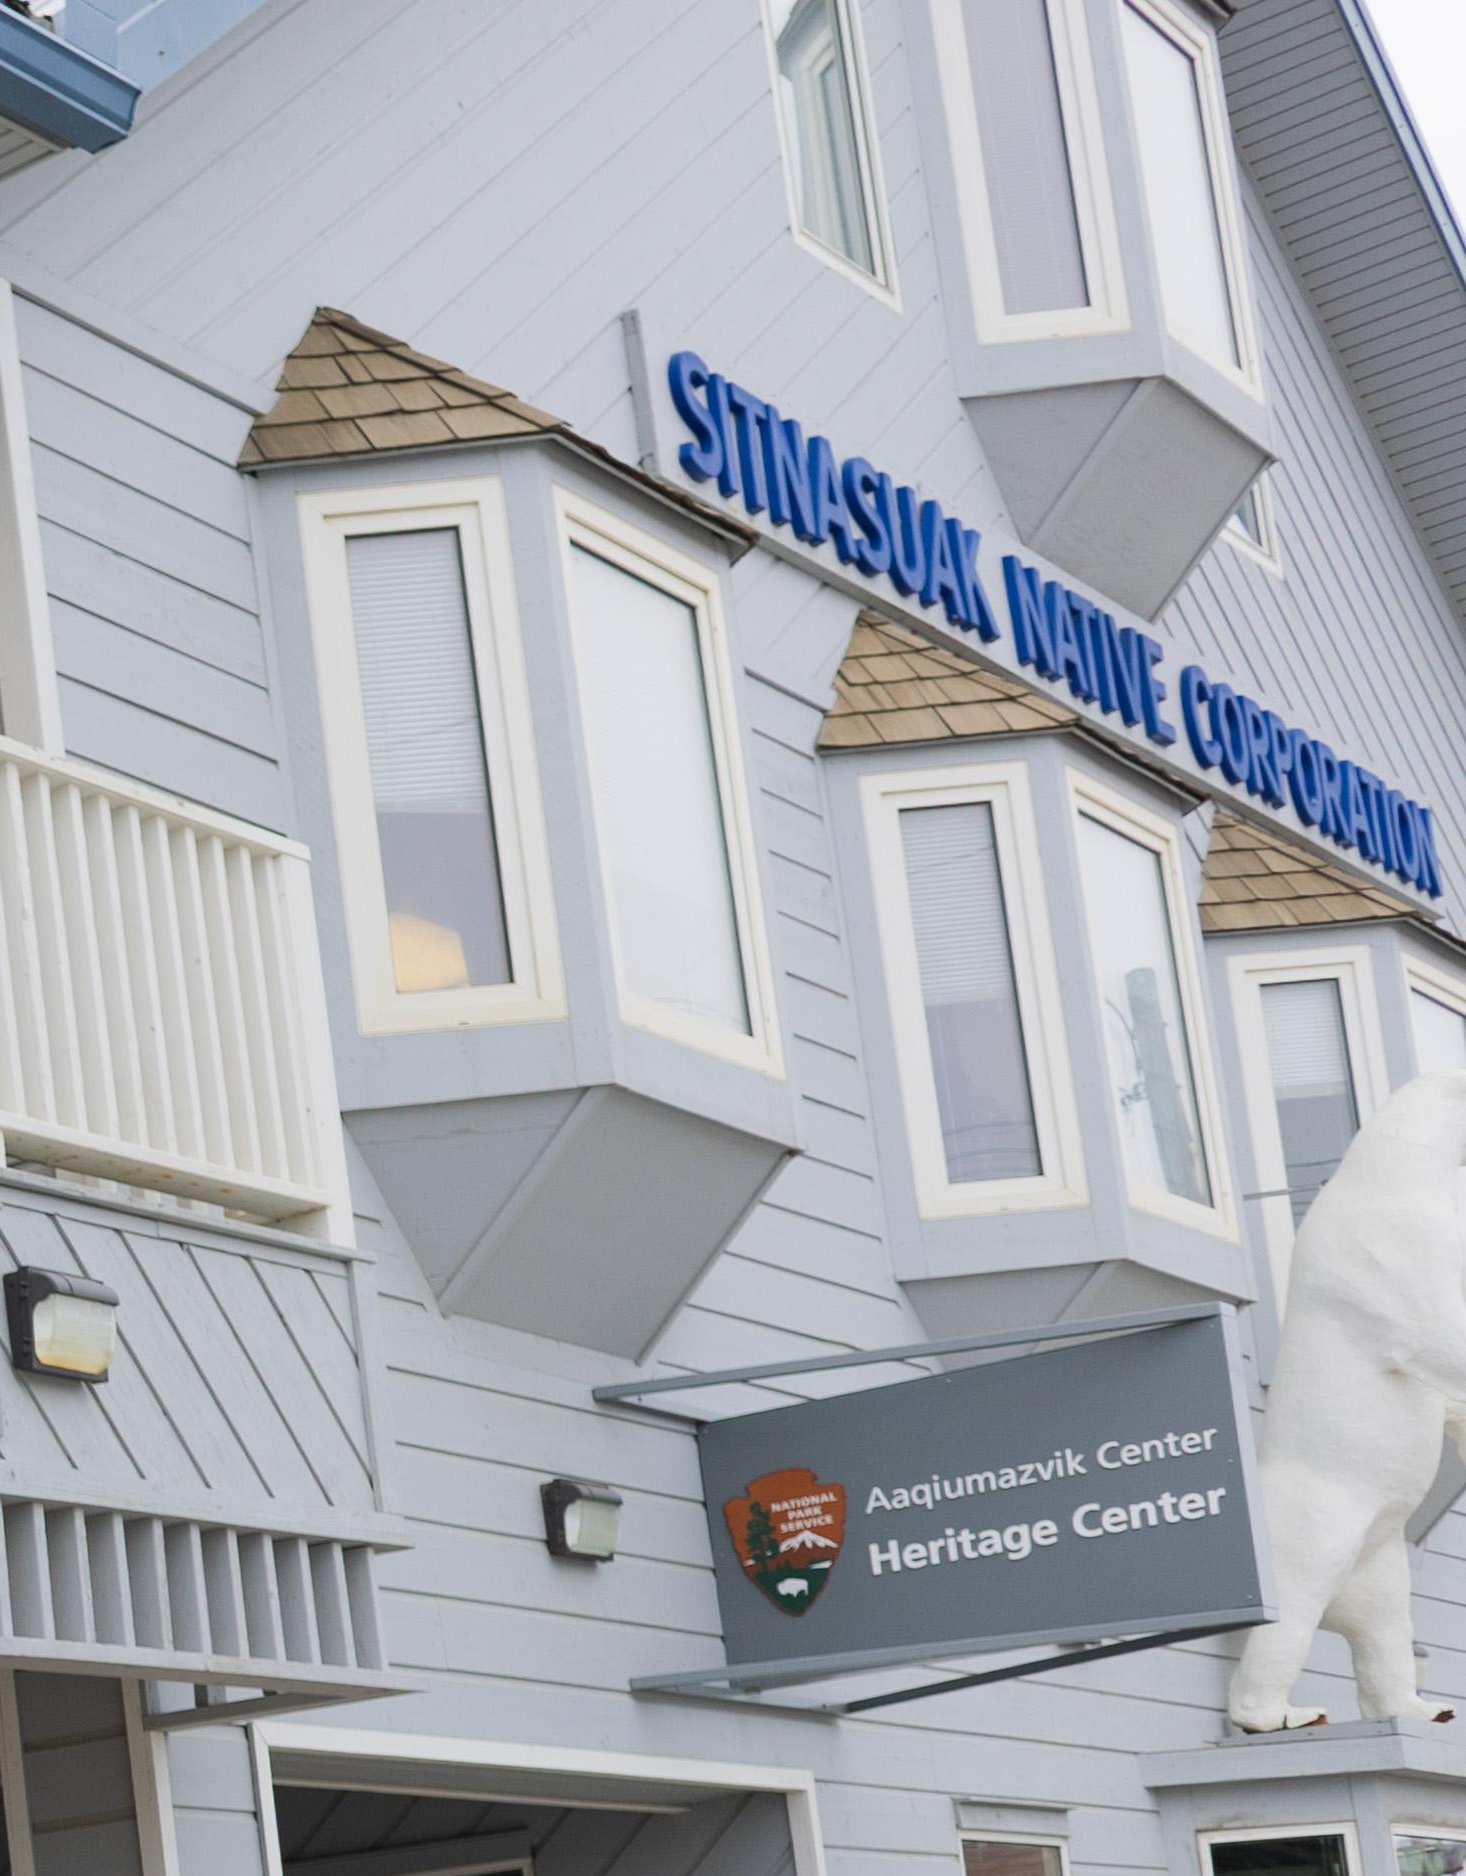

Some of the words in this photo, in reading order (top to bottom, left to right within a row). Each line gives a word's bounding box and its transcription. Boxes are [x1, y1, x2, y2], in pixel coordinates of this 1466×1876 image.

[668, 351, 1000, 642] SITNASUAK
[1003, 555, 1175, 746] NATIVE
[1180, 665, 1443, 899] CORPORATION
[865, 1449, 1087, 1514] Aaqiumazvik
[1097, 1427, 1218, 1470] Center
[771, 1491, 838, 1514] NATIONAL
[779, 1513, 834, 1534] SERVICE
[787, 1505, 823, 1521] PARK
[869, 1517, 1059, 1575] Heritage
[1073, 1487, 1226, 1539] Center
